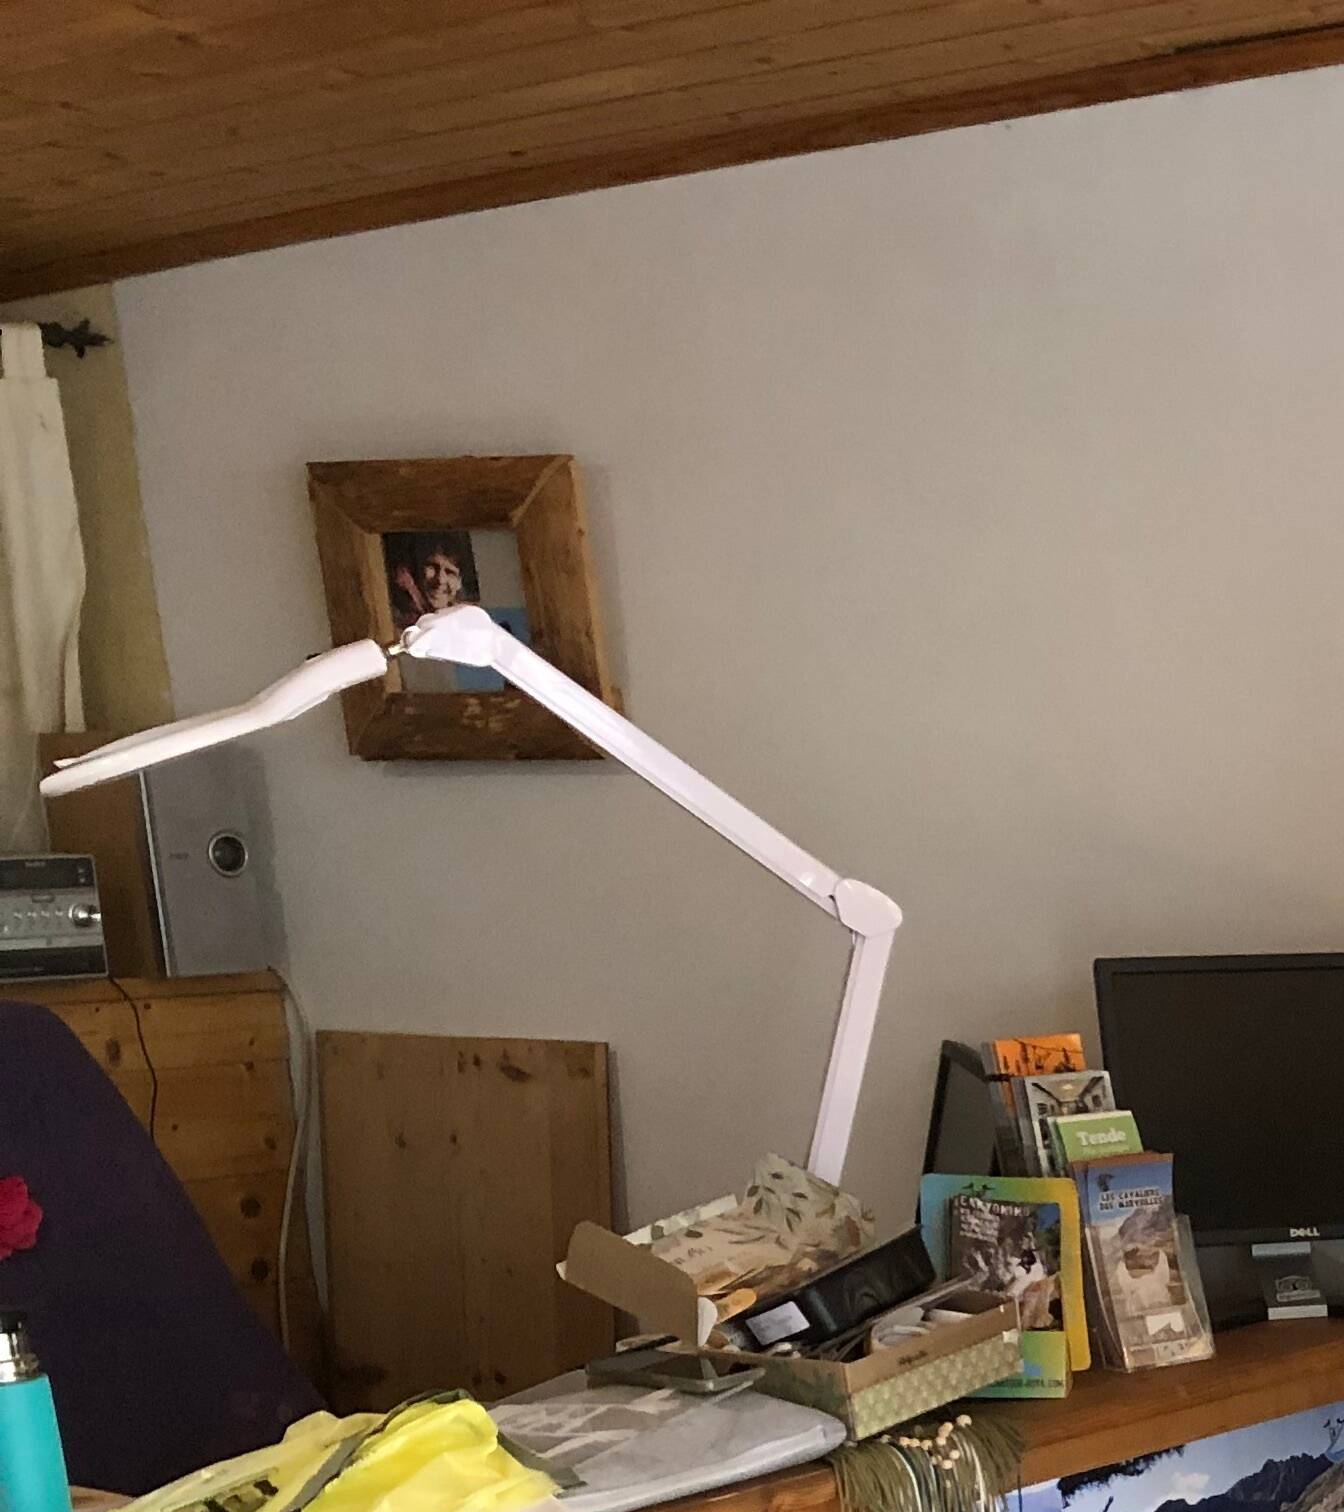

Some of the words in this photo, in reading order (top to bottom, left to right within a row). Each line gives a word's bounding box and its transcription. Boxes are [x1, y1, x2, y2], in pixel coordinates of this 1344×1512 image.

[1076, 1128, 1126, 1146] Tende
[1101, 1192, 1115, 1202] LES
[1289, 1227, 1320, 1238] DELL
